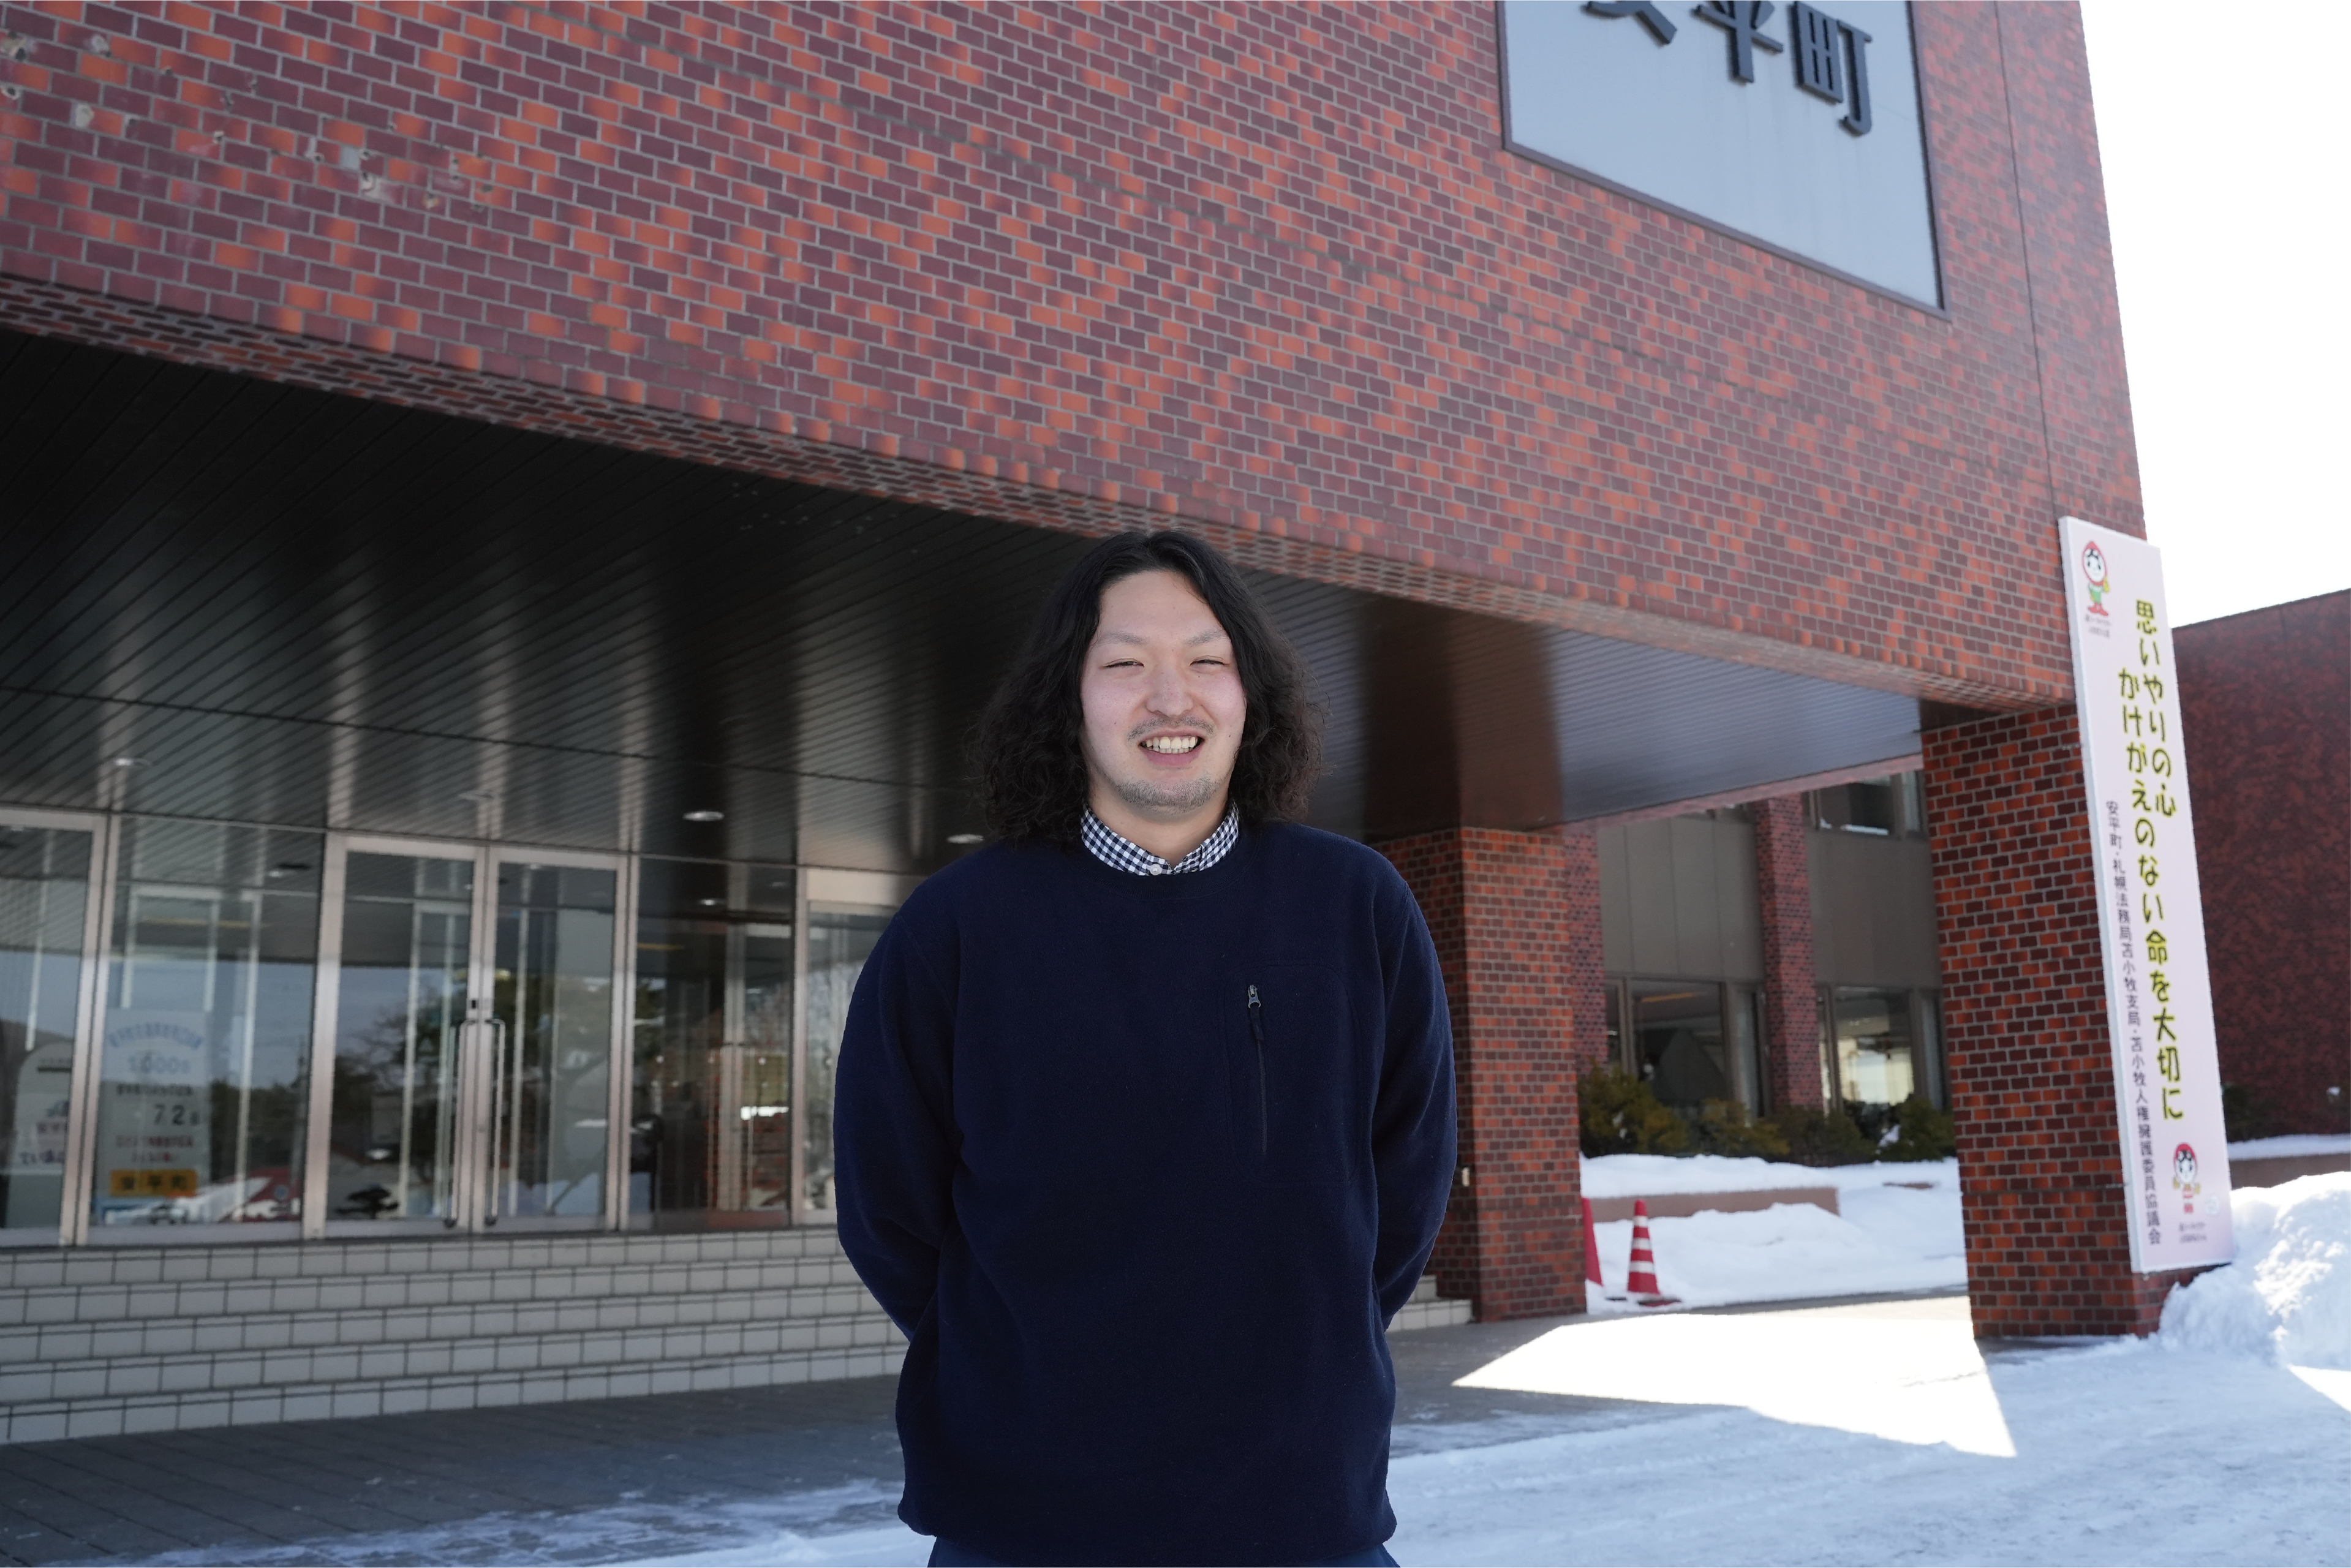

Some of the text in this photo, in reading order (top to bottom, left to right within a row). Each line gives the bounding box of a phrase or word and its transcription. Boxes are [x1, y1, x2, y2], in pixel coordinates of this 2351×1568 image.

[2135, 599, 2177, 817] 思いやりの心
[2118, 667, 2183, 1120] かけがえのない命を大切に
